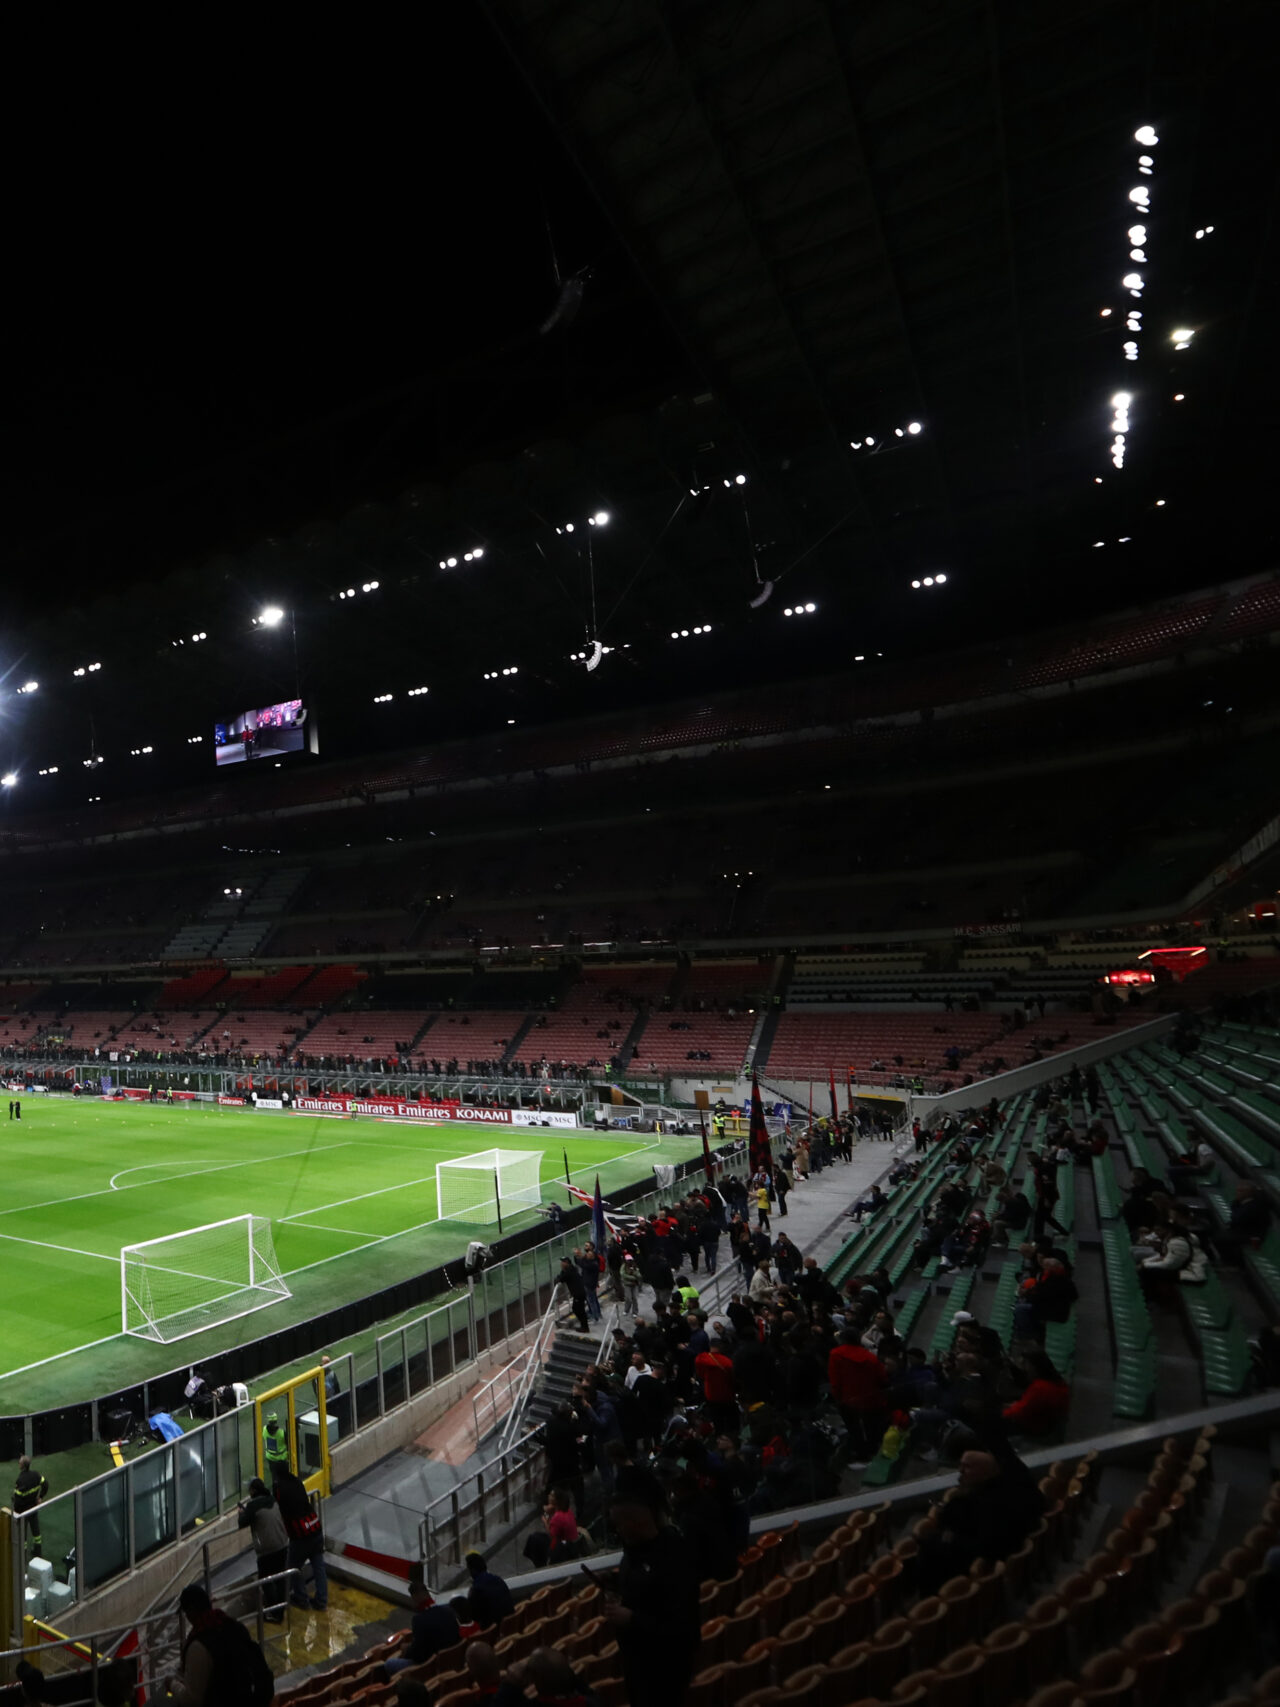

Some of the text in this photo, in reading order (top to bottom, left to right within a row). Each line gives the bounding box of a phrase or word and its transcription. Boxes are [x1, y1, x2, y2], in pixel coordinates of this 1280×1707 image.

[218, 1097, 244, 1105] Emirates
[297, 1097, 509, 1122] Emirates Emirates Emirates KONAMI
[555, 1117, 573, 1125] MSC
